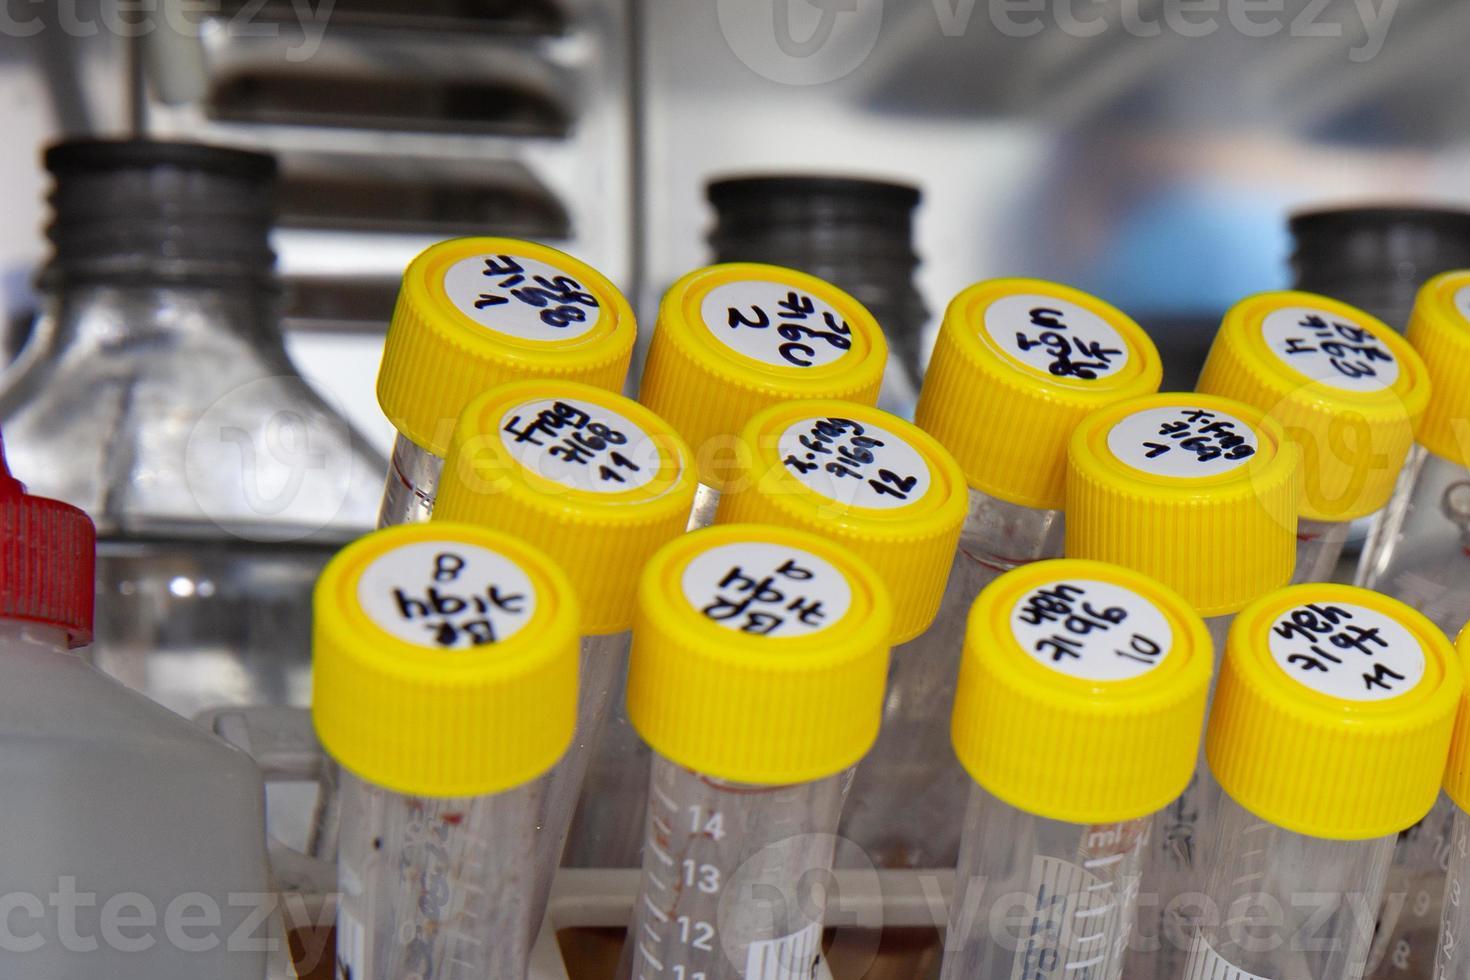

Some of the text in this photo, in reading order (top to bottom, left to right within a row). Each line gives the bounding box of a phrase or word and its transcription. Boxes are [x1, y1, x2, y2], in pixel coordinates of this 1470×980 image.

[475, 293, 509, 309] 1
[728, 305, 770, 328] 2
[549, 422, 628, 464] 7168
[600, 451, 640, 482] 11
[868, 468, 917, 500] 12
[433, 553, 464, 583] 8
[1035, 601, 1128, 661] 7196
[1115, 633, 1161, 664] 10
[688, 805, 727, 841] 14
[681, 859, 721, 893] 13
[677, 916, 715, 951] 12
